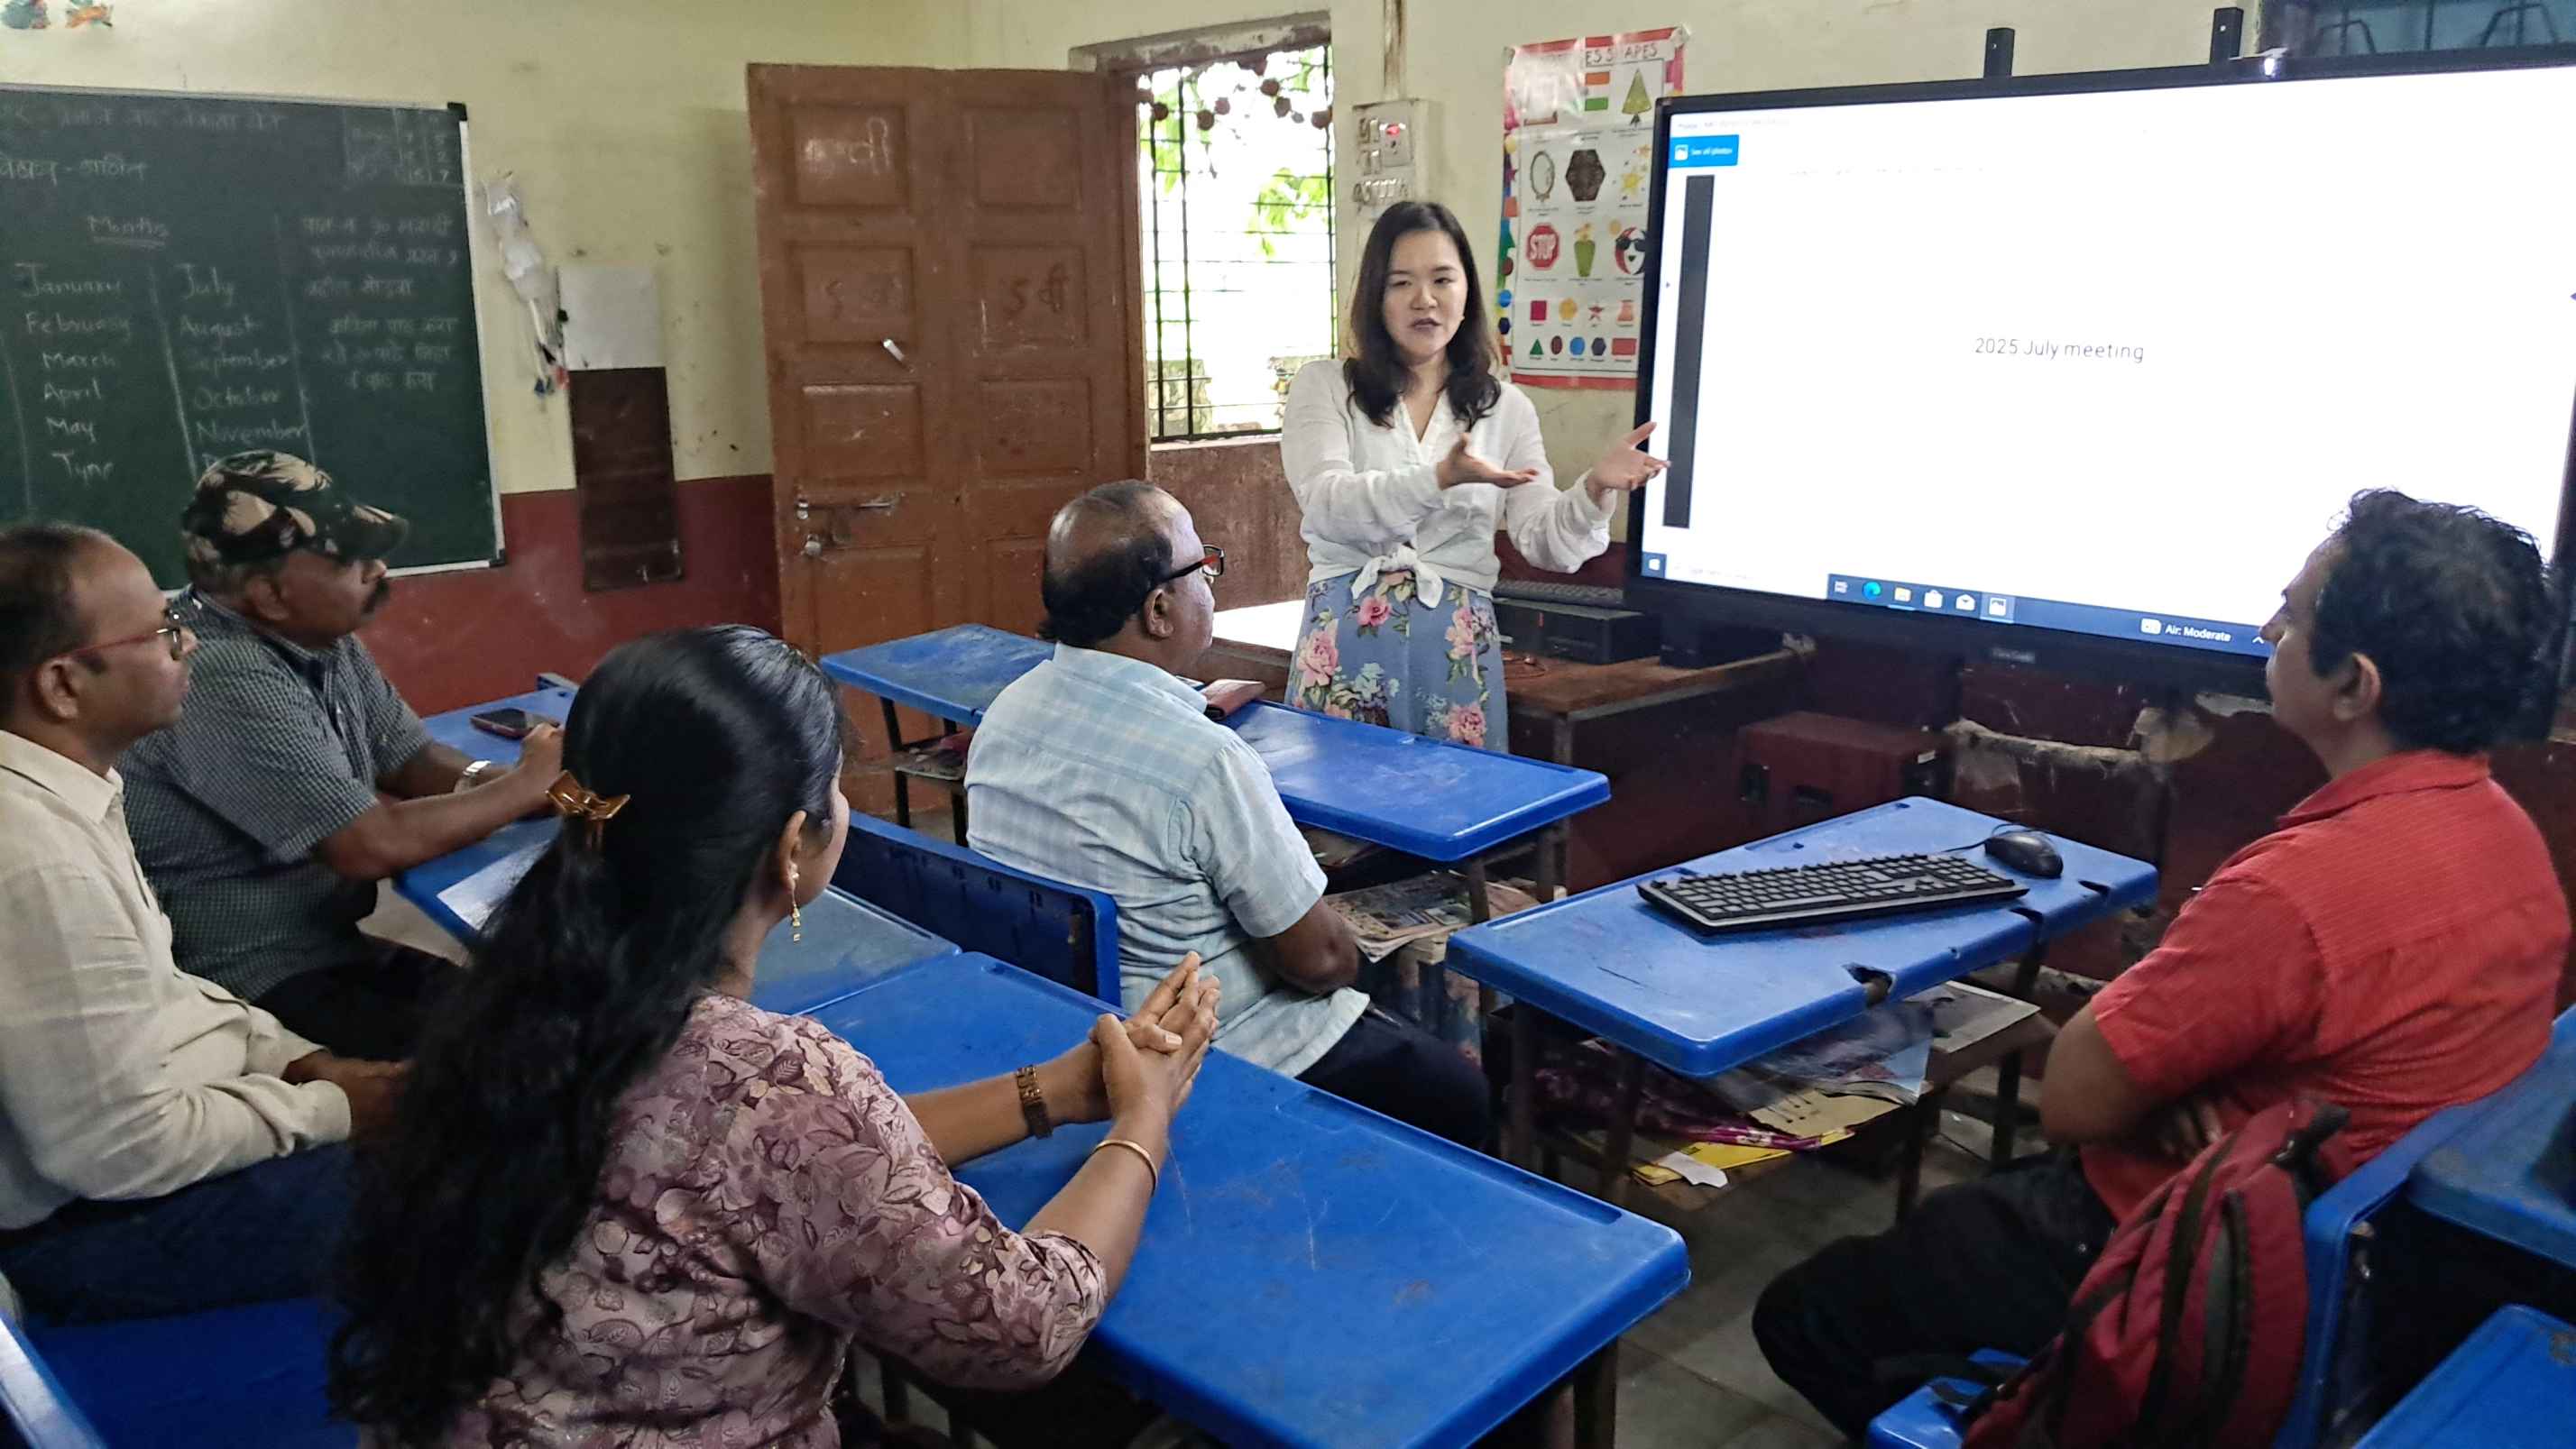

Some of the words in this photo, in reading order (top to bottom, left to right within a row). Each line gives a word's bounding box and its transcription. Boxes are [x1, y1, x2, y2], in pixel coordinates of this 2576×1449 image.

[1605, 44, 1658, 62] SAPES
[1975, 337, 2019, 354] 2025
[2023, 340, 2058, 361] July
[2064, 344, 2145, 364] meeting
[2166, 624, 2182, 635] Air:
[2184, 627, 2231, 642] Moderate
